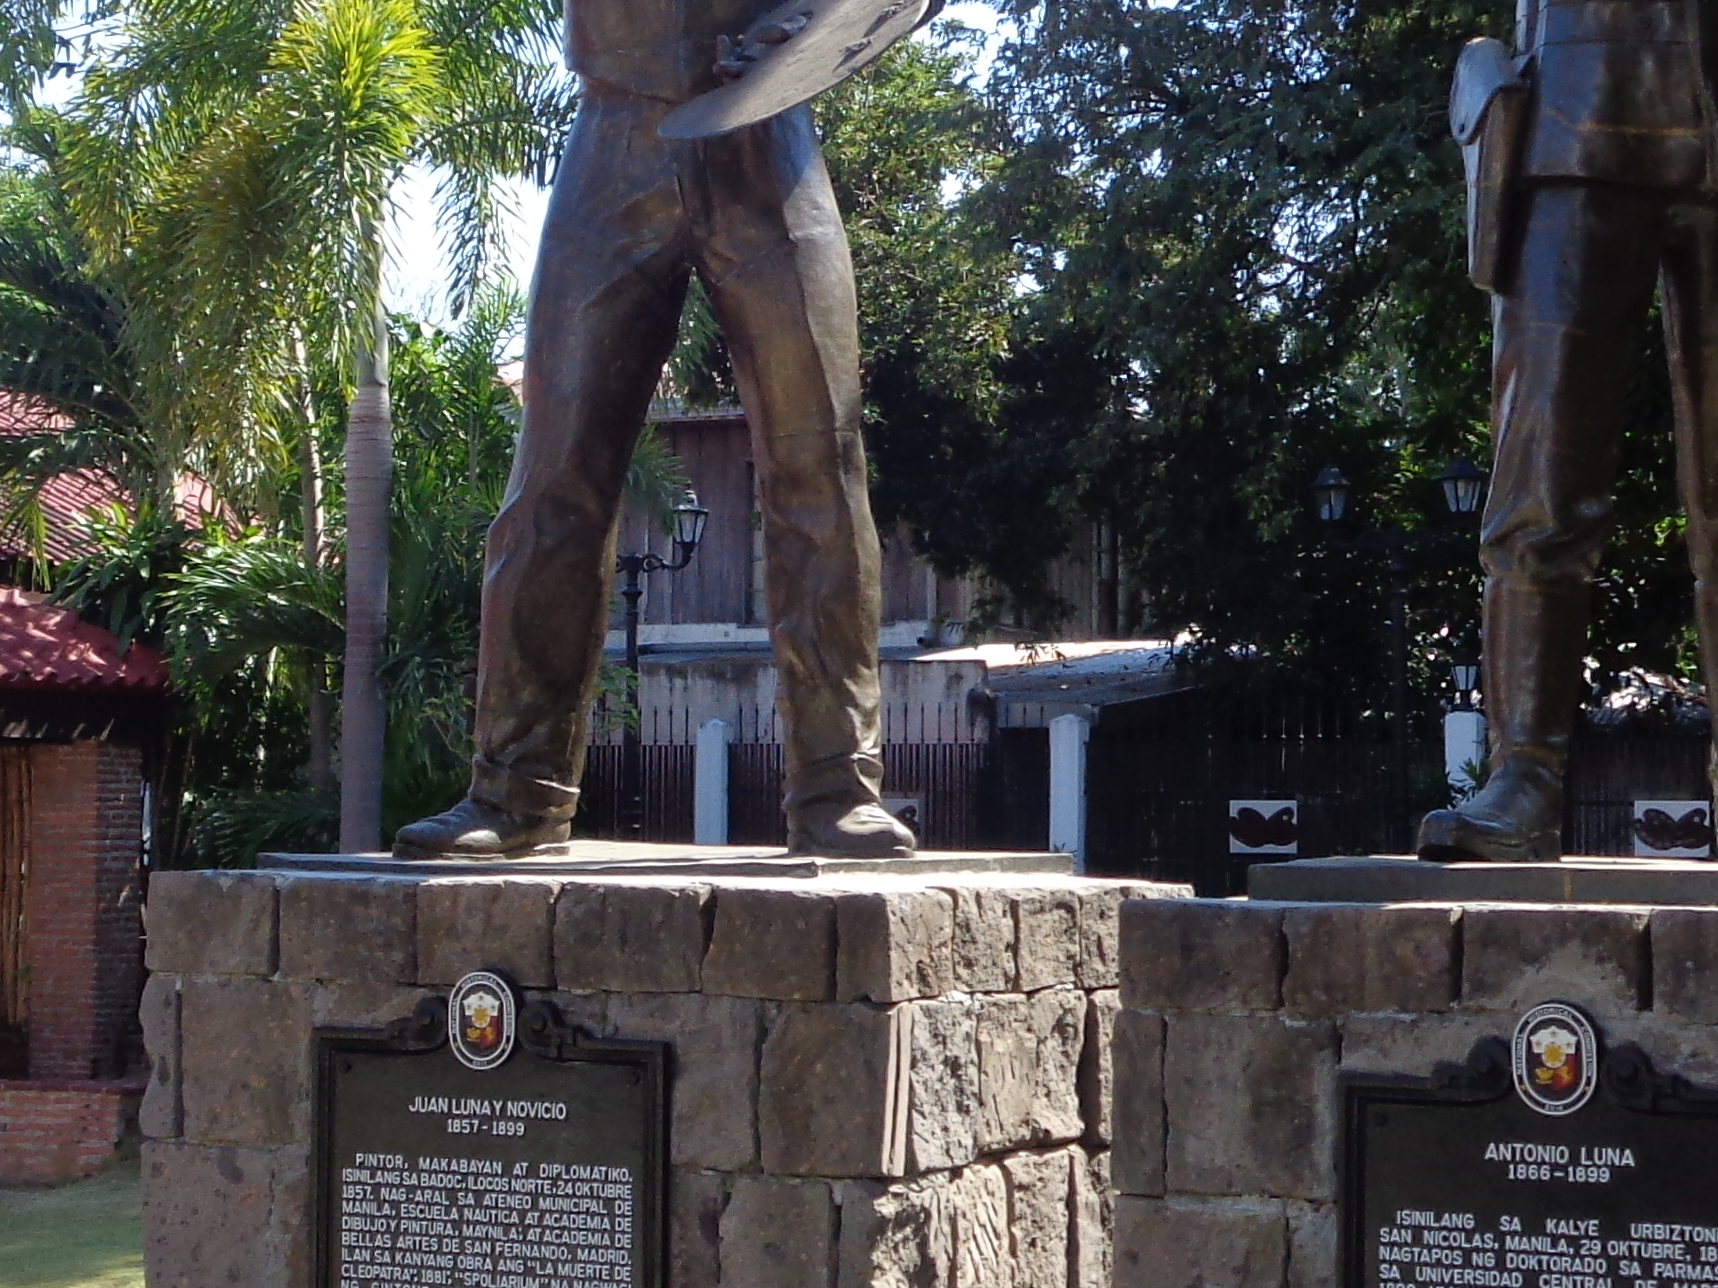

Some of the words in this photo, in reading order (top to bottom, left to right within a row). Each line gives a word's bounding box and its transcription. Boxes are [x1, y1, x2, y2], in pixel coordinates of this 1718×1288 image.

[408, 1096, 448, 1113] JUAN
[451, 1097, 491, 1115] LUNA
[493, 1099, 501, 1116] Y
[506, 1100, 566, 1119] NOVICIO
[355, 1153, 408, 1169] PINTOR,
[418, 1156, 502, 1174] MAKABAYAN
[512, 1161, 527, 1176] AT
[539, 1163, 632, 1182] DIPLOMATIKO.
[1484, 1142, 1573, 1164] ANTONIO
[1580, 1146, 1635, 1166] LUNA
[380, 1186, 450, 1204] NAG-ARAL
[457, 1190, 474, 1206] SA
[482, 1191, 531, 1209] ATENEO
[538, 1195, 607, 1213] MUNICIPAL
[614, 1199, 632, 1215] DE
[341, 1199, 395, 1216] MANILA,
[400, 1203, 459, 1220] ESCUELA
[463, 1206, 519, 1224] NAUTICA
[524, 1210, 538, 1225] AT
[542, 1211, 611, 1230] ACADEMIA
[614, 1215, 632, 1231] DE
[1396, 1210, 1474, 1229] ISINILANG
[1498, 1215, 1521, 1232] SA
[1545, 1217, 1599, 1236] KALYE
[341, 1230, 391, 1248] BELLAS
[395, 1234, 438, 1251] ARTES
[442, 1237, 460, 1253] DE
[464, 1238, 491, 1255] SAN
[494, 1240, 571, 1260] FERNANDO,
[576, 1246, 631, 1264] MADRID.
[1378, 1263, 1400, 1281] SA
[1415, 1265, 1523, 1288] UNIVERSIDAD
